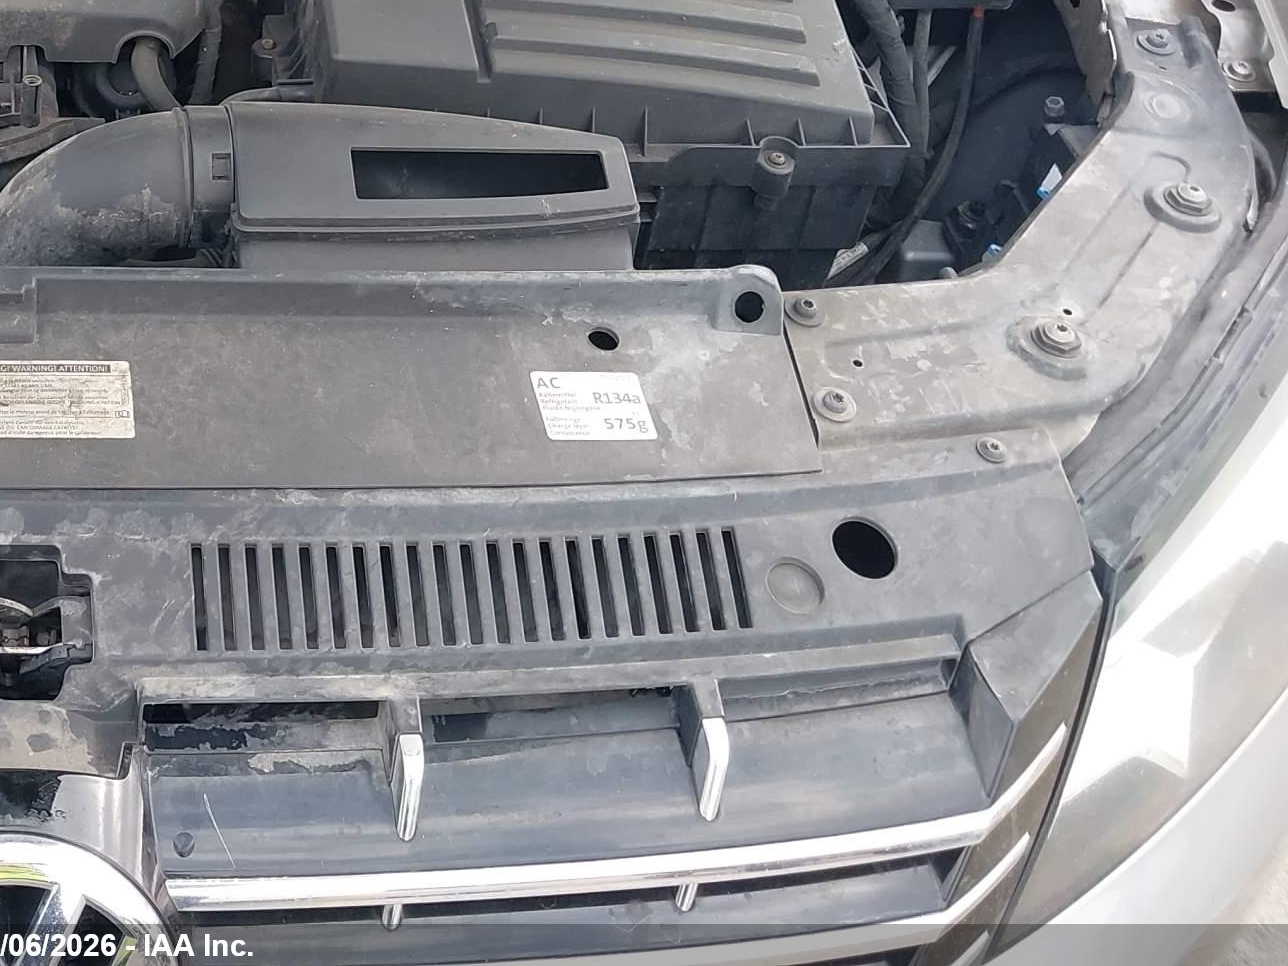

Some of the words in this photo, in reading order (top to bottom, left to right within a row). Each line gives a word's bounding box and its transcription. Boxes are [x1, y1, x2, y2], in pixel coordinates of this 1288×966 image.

[11, 364, 57, 373] WARNING!
[60, 365, 108, 373] ATTENTION!
[592, 392, 641, 404] R134a
